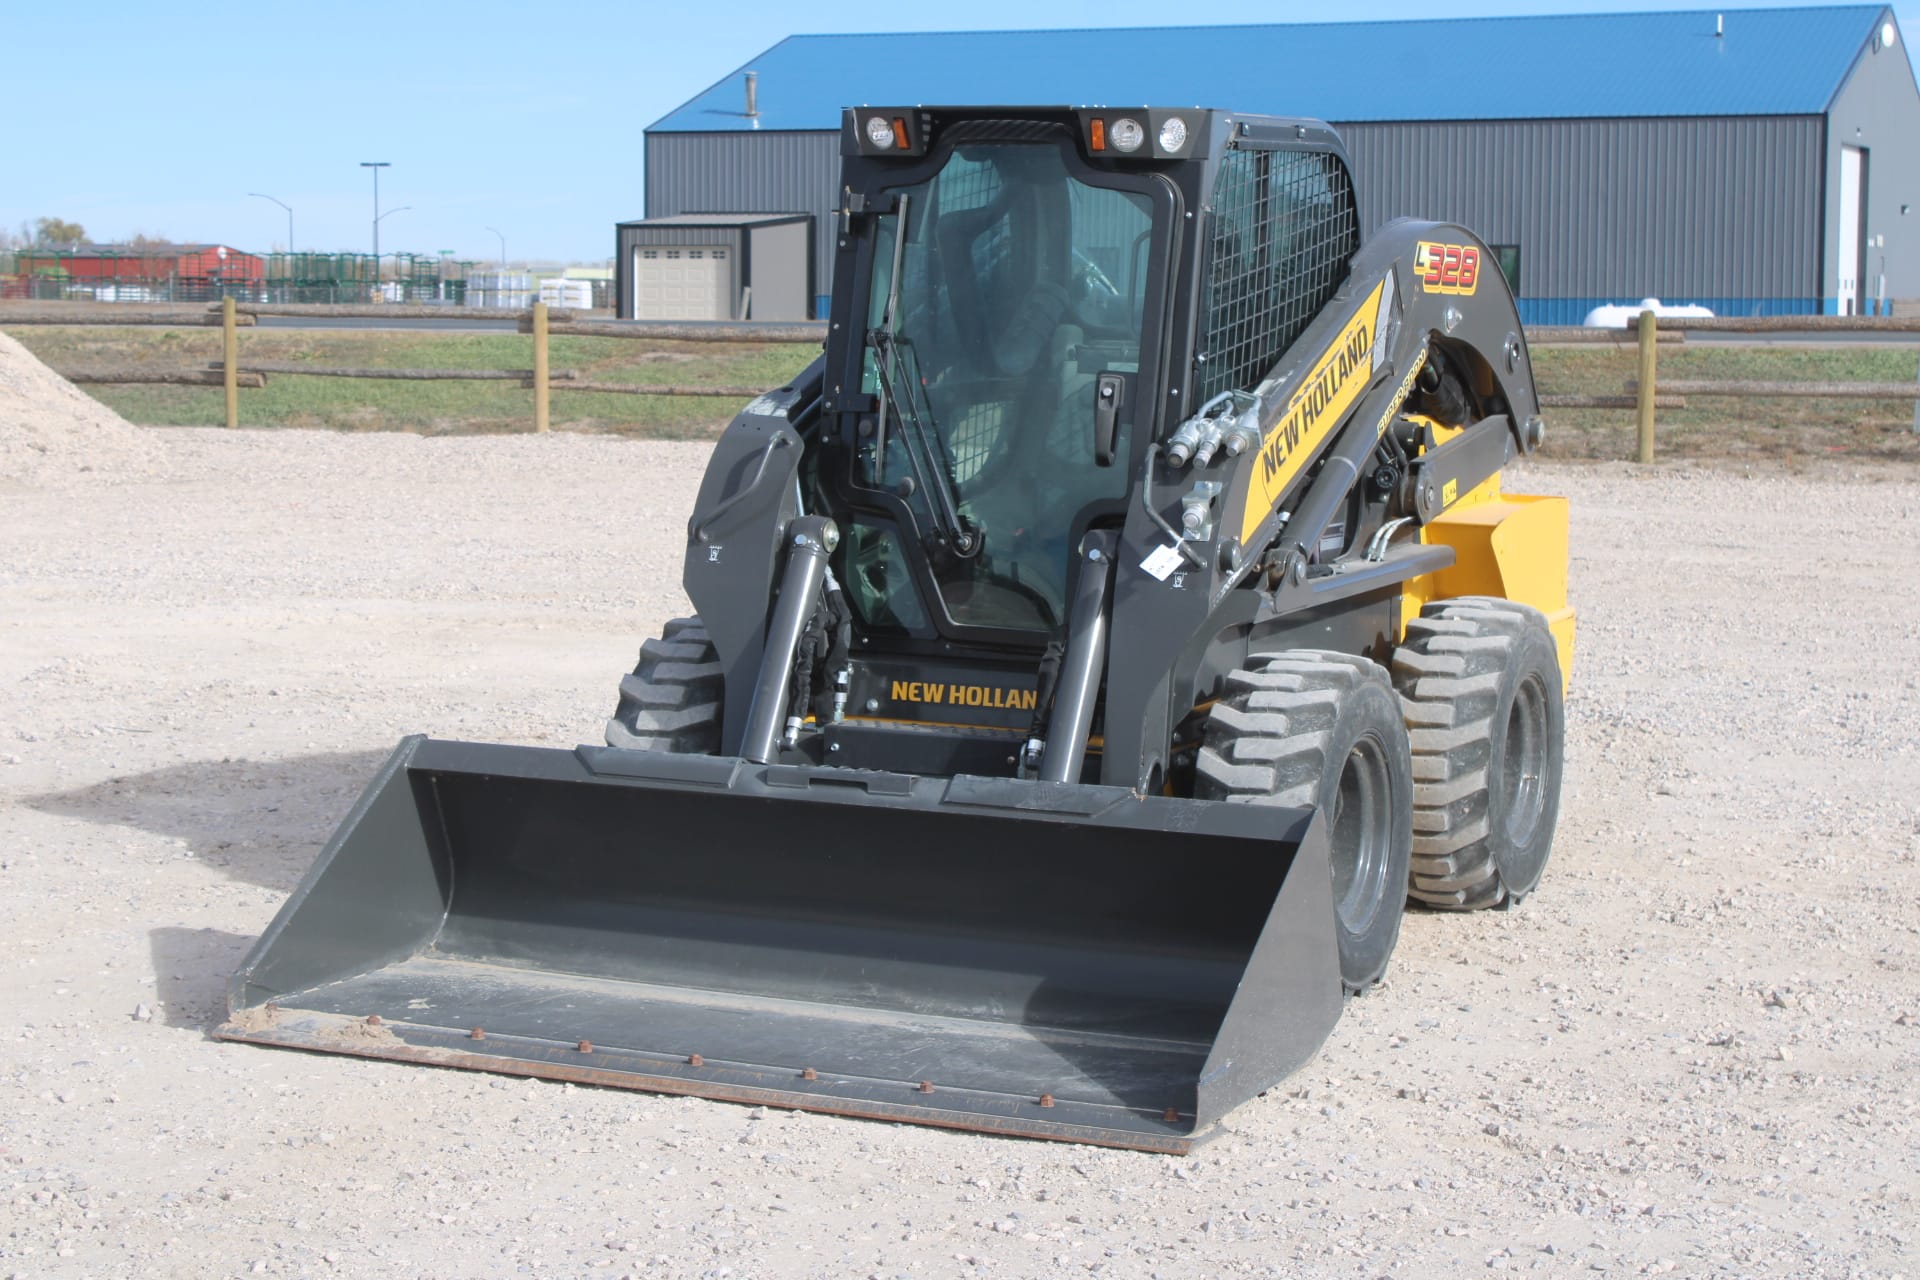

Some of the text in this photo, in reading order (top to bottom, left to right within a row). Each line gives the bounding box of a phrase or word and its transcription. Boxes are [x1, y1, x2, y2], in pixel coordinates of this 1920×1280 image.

[1263, 325, 1368, 483] NEW HOLLAND
[891, 680, 1038, 710] NEW HOLLAN
